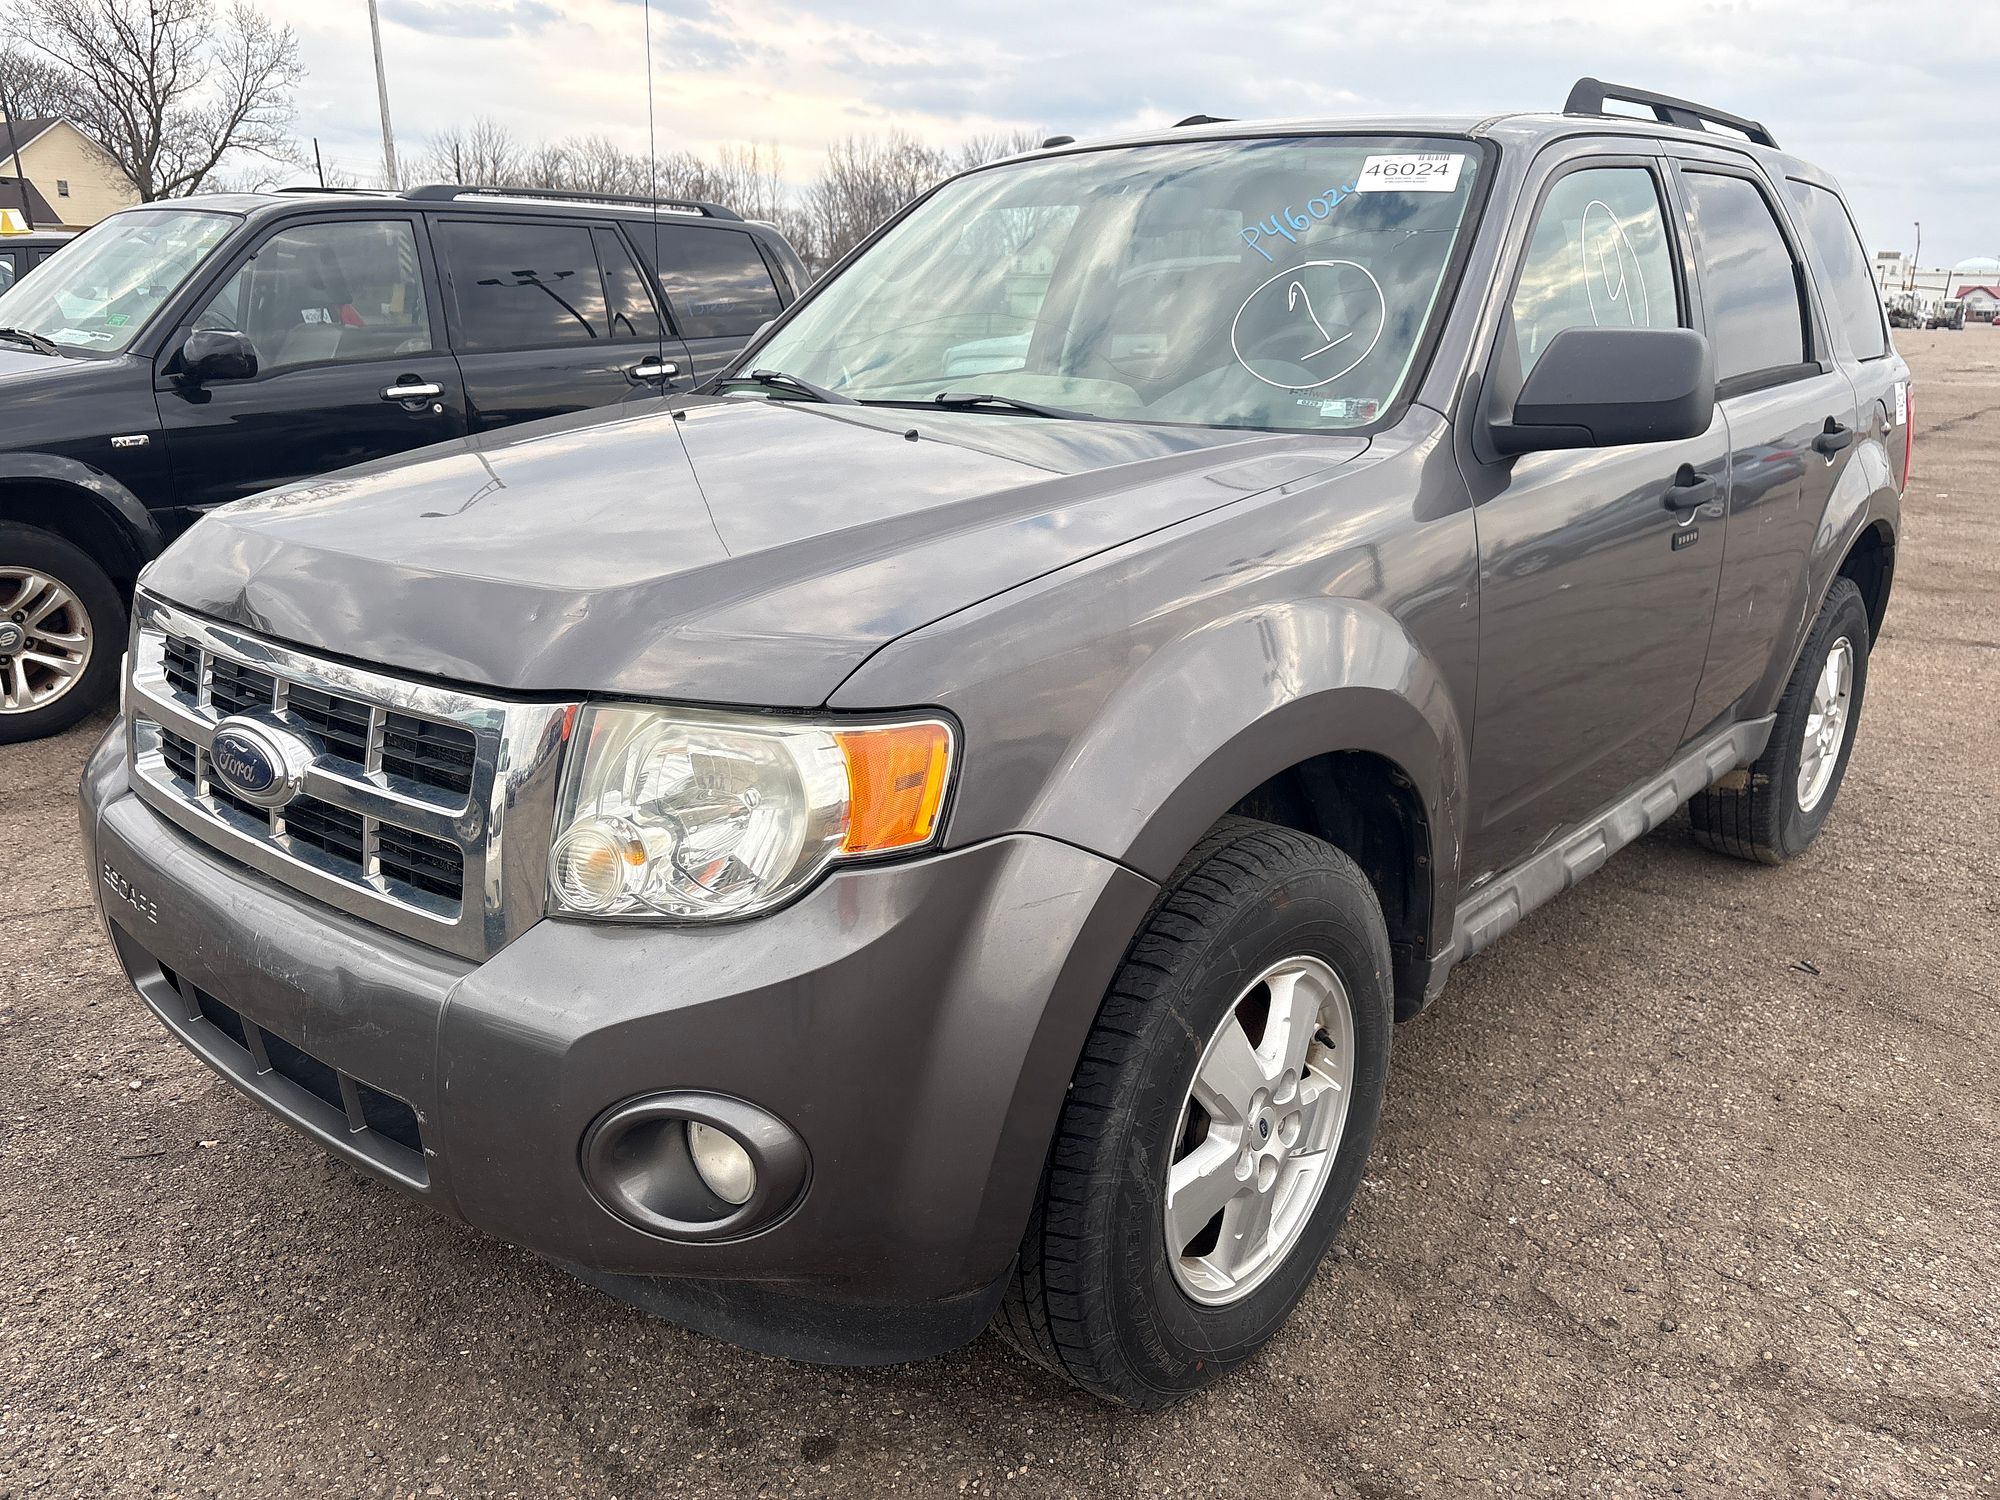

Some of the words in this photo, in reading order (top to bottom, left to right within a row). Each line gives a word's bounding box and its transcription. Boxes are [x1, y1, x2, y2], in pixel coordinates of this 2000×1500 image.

[1365, 162, 1449, 176] 46024
[219, 739, 257, 782] Ford
[103, 864, 158, 924] ESCAPE
